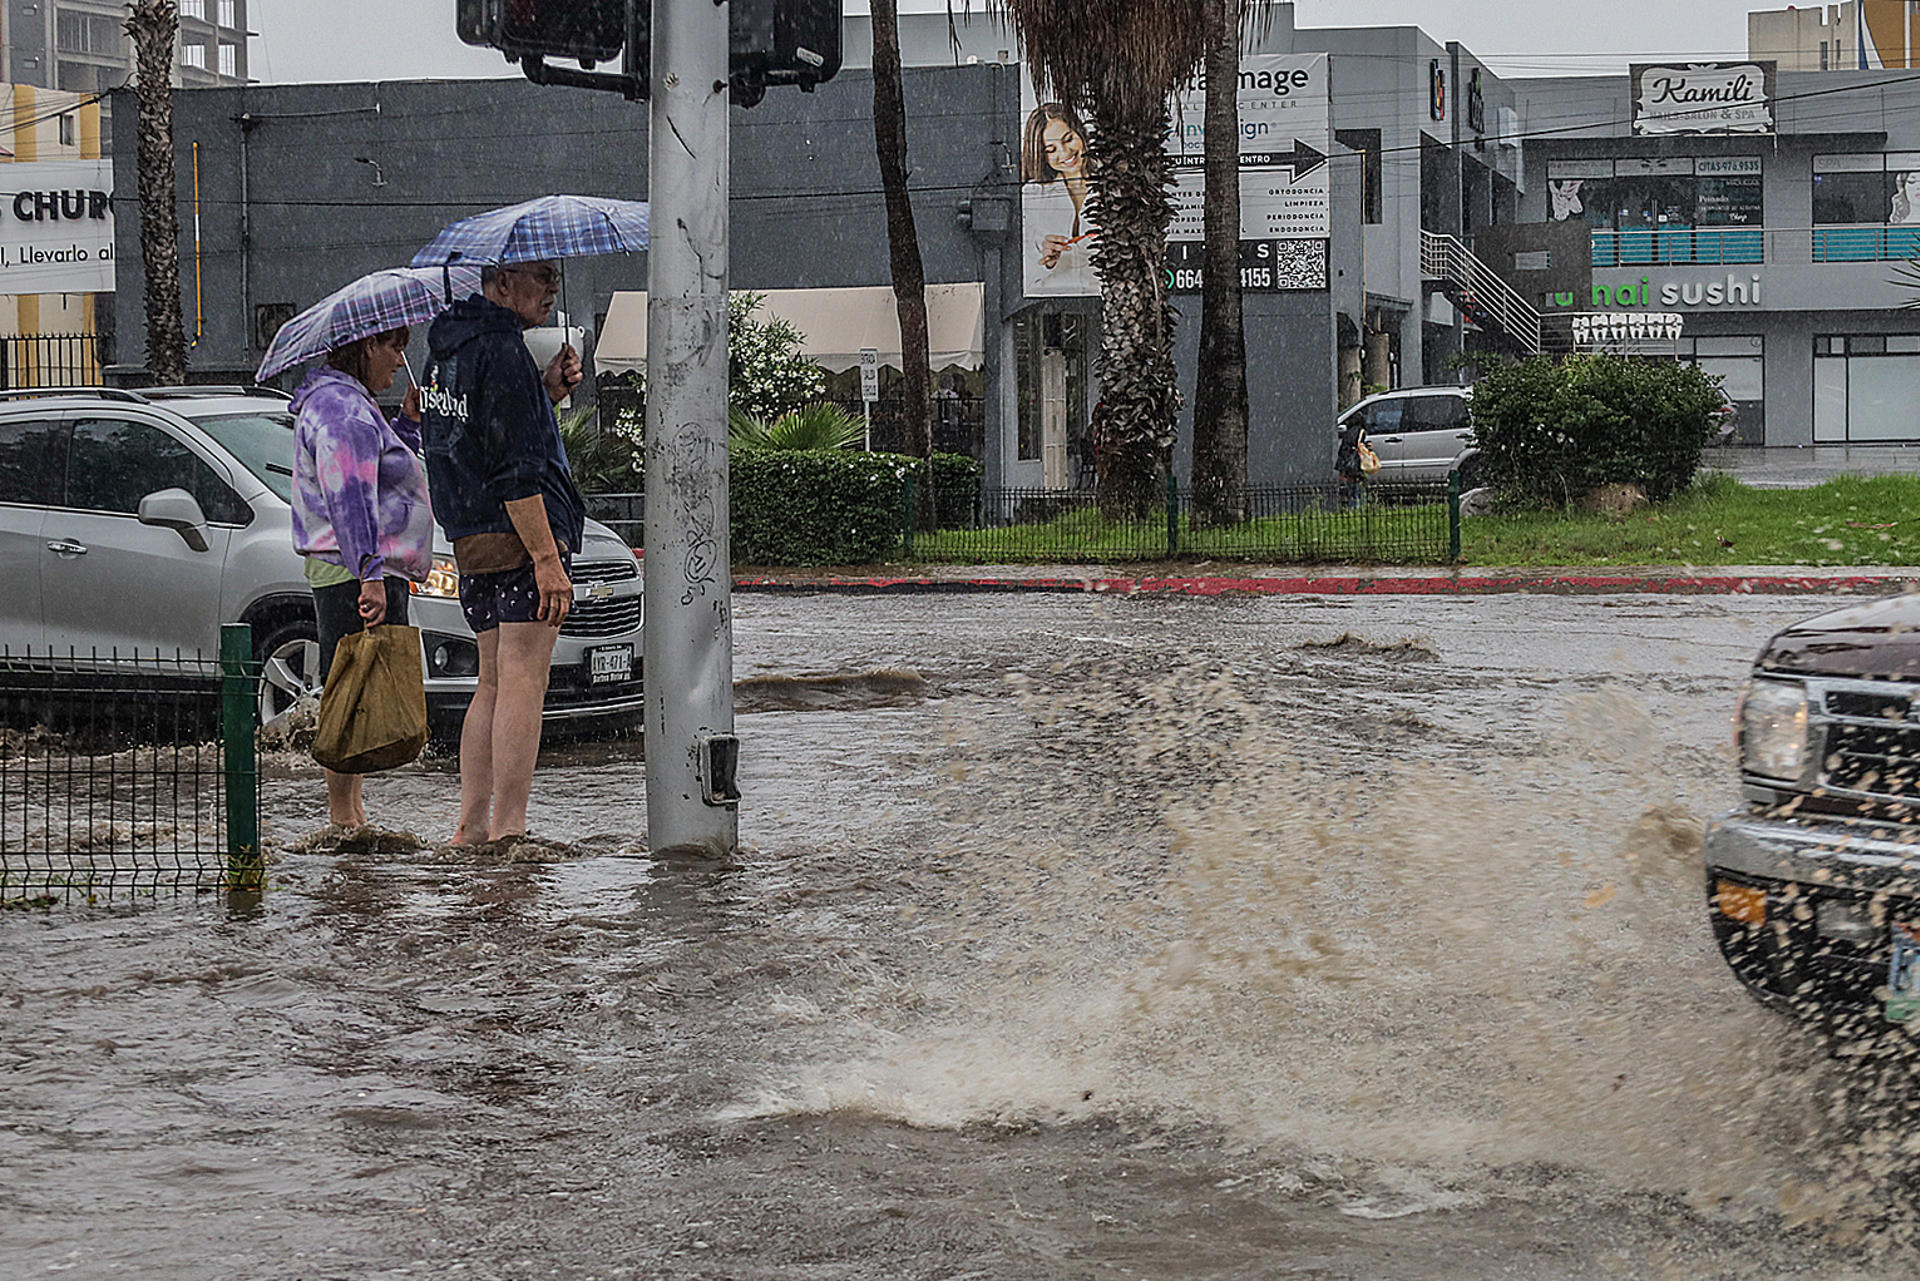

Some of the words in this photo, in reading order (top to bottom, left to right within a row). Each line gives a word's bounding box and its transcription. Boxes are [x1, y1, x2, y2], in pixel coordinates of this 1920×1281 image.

[1651, 73, 1754, 104] Kamili
[1238, 101, 1298, 110] CENTER
[1735, 109, 1756, 120] SPA
[13, 189, 114, 221] CHUR
[19, 244, 89, 264] Llevarlo
[1661, 274, 1760, 306] sushi
